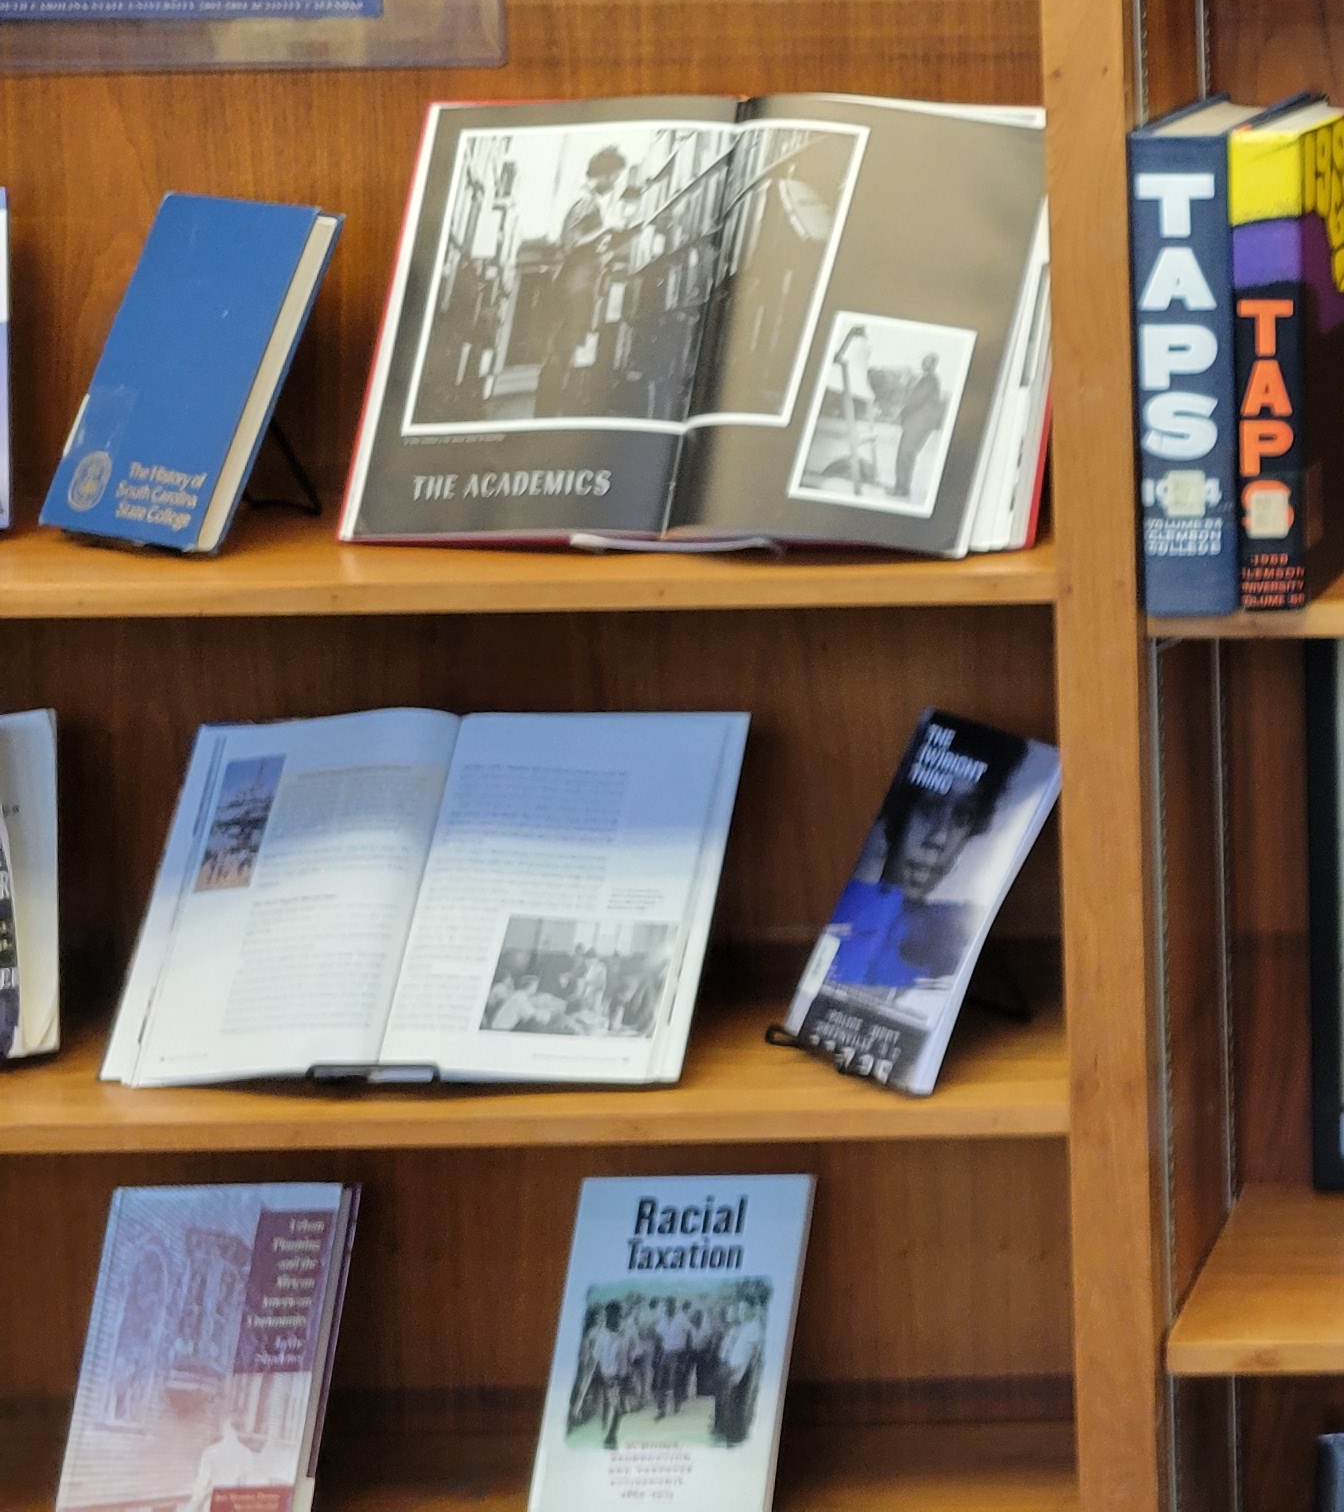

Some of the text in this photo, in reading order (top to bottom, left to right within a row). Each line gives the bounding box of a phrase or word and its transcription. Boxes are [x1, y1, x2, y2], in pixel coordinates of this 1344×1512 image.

[1134, 172, 1218, 460] TAPS
[130, 462, 208, 490] The History of
[413, 469, 612, 501] THE ACADEMICS
[116, 480, 198, 509] South Carolina
[116, 501, 191, 532] State College
[924, 724, 956, 747] THE
[910, 763, 954, 795] THING
[634, 1195, 749, 1237] Racial
[625, 1239, 744, 1272] Taxation
